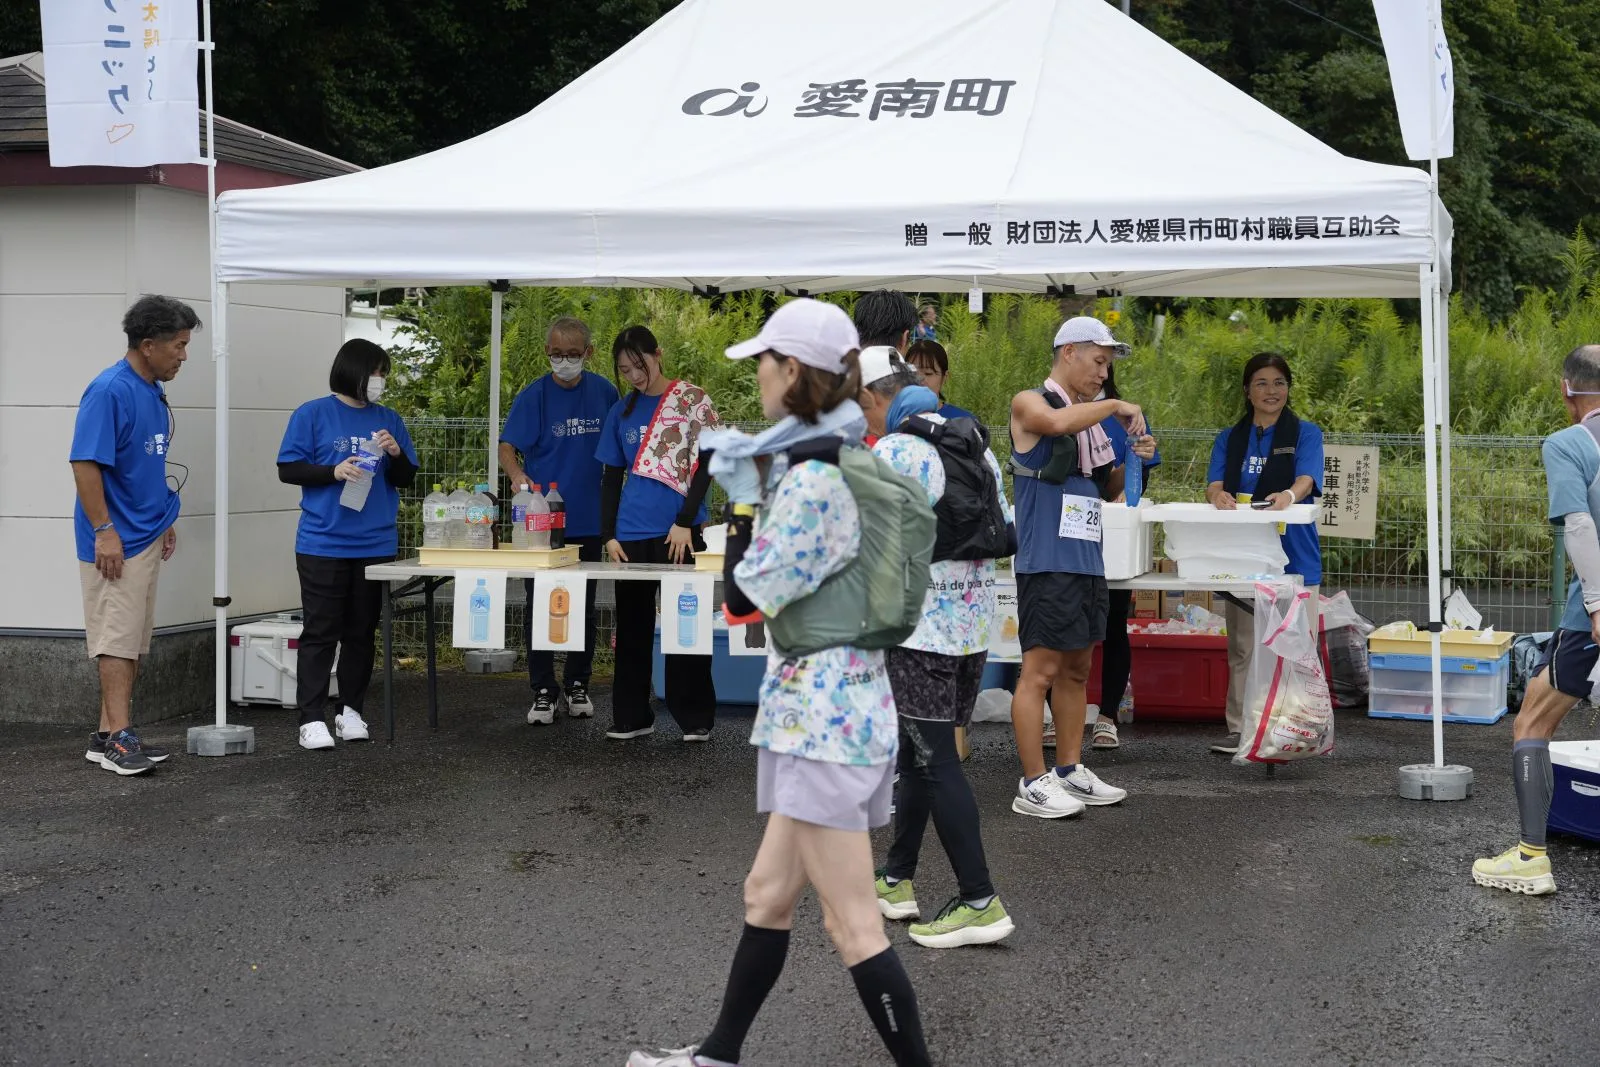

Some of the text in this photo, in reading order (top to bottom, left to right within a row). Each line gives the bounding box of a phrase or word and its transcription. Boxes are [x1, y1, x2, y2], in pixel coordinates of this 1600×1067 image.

[793, 78, 1017, 121] 愛南町
[904, 223, 928, 247] 贈
[1321, 457, 1341, 527] 駐車禁止
[1345, 473, 1355, 513] 利用者以外
[950, 580, 965, 591] de
[475, 599, 485, 609] 水
